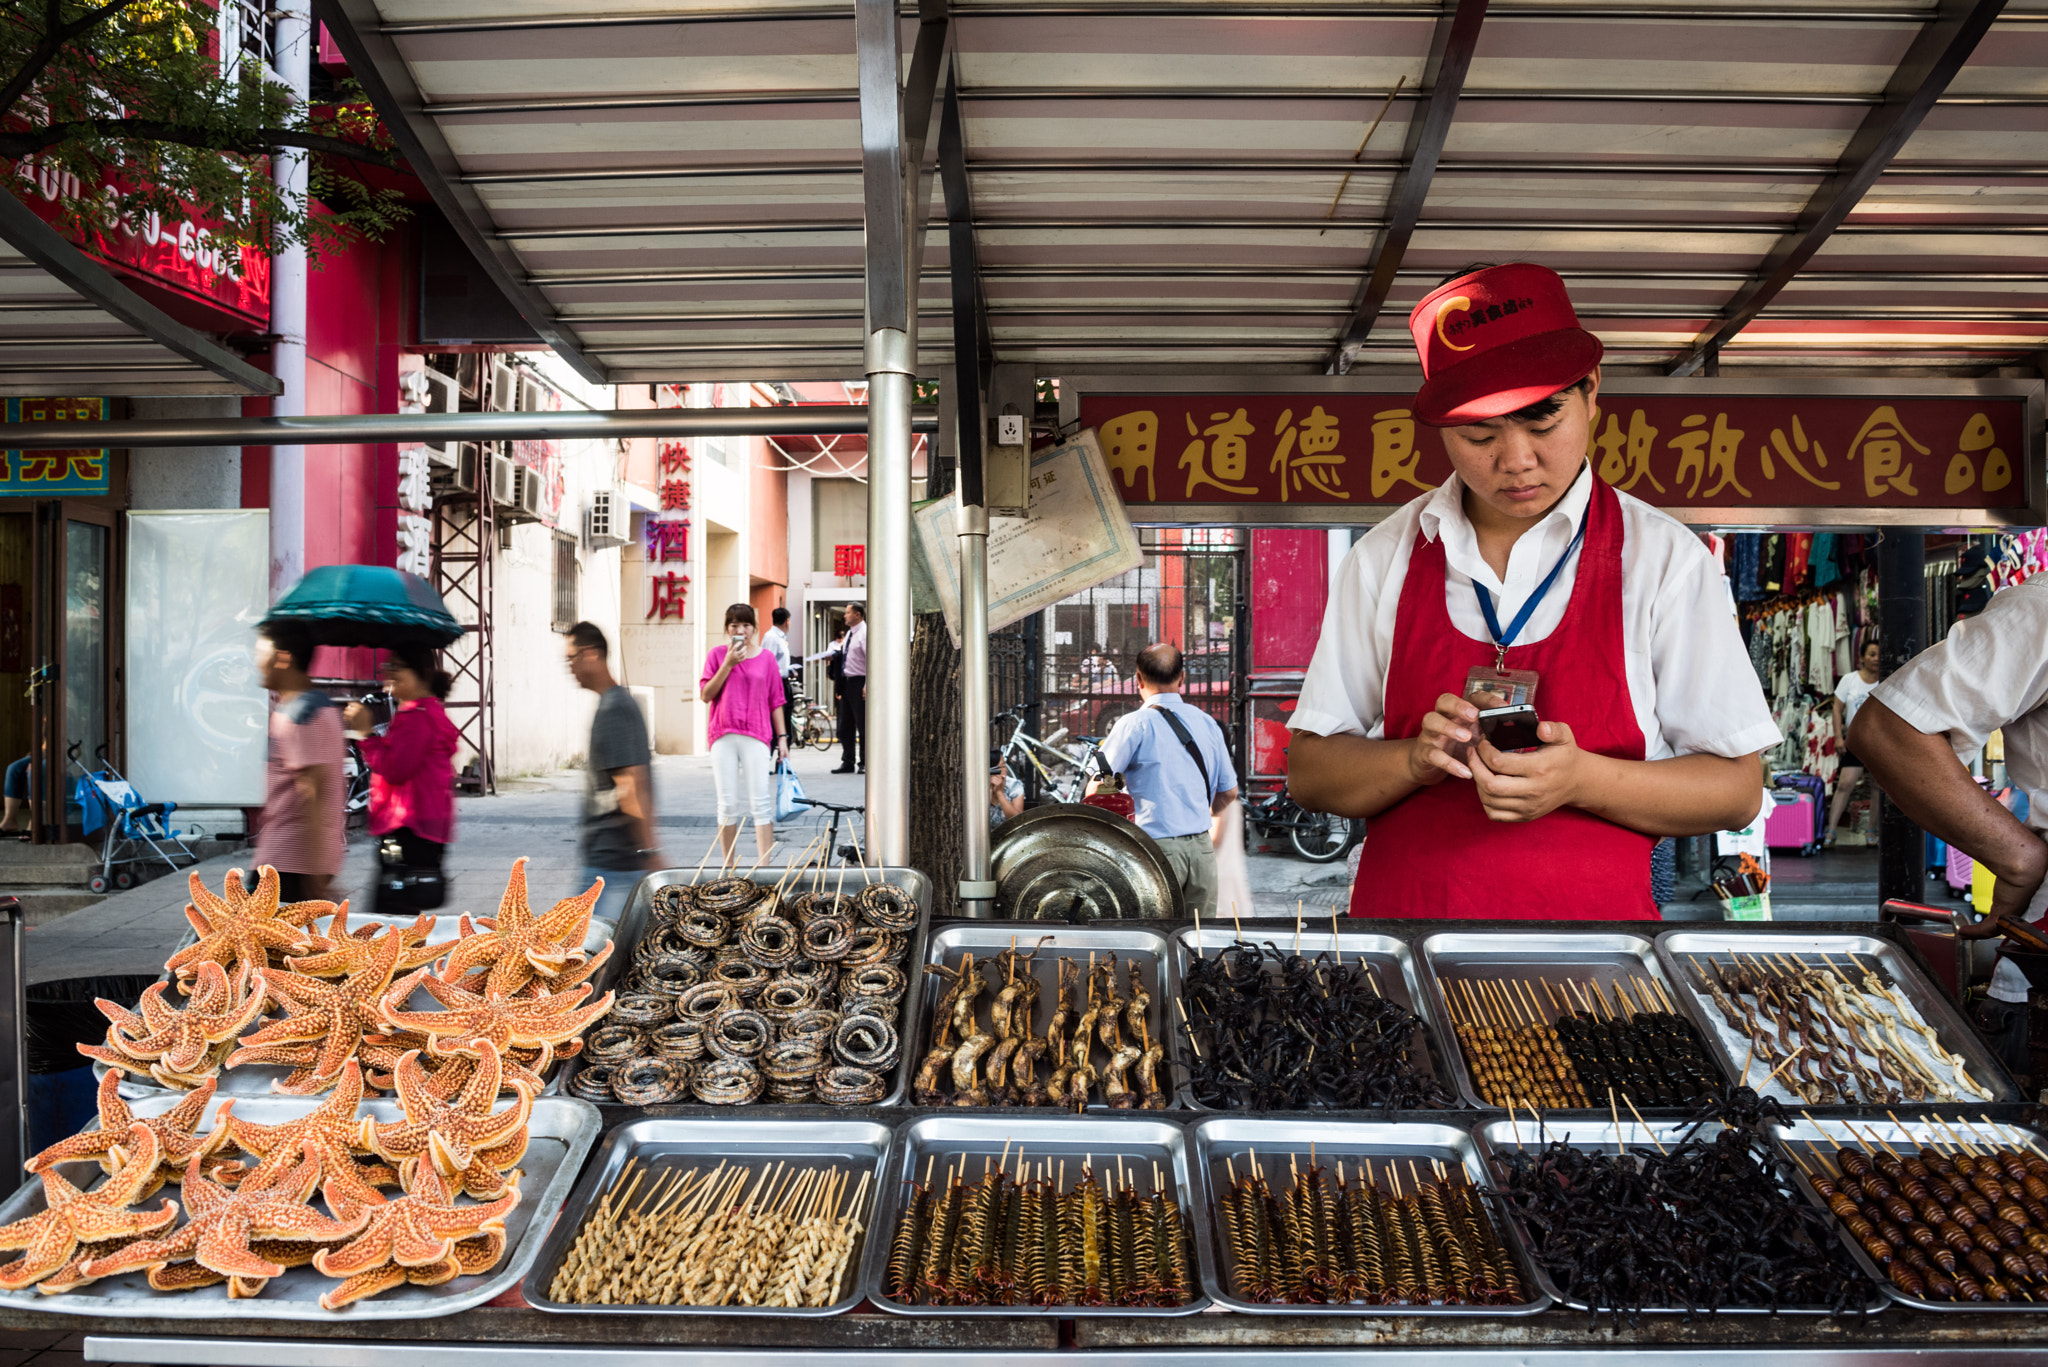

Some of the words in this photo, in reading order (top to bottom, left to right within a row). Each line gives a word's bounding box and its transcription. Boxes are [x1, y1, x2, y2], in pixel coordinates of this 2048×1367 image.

[646, 384, 691, 620] 快捷酒店
[1098, 405, 2012, 502] 用道德良做放心食品
